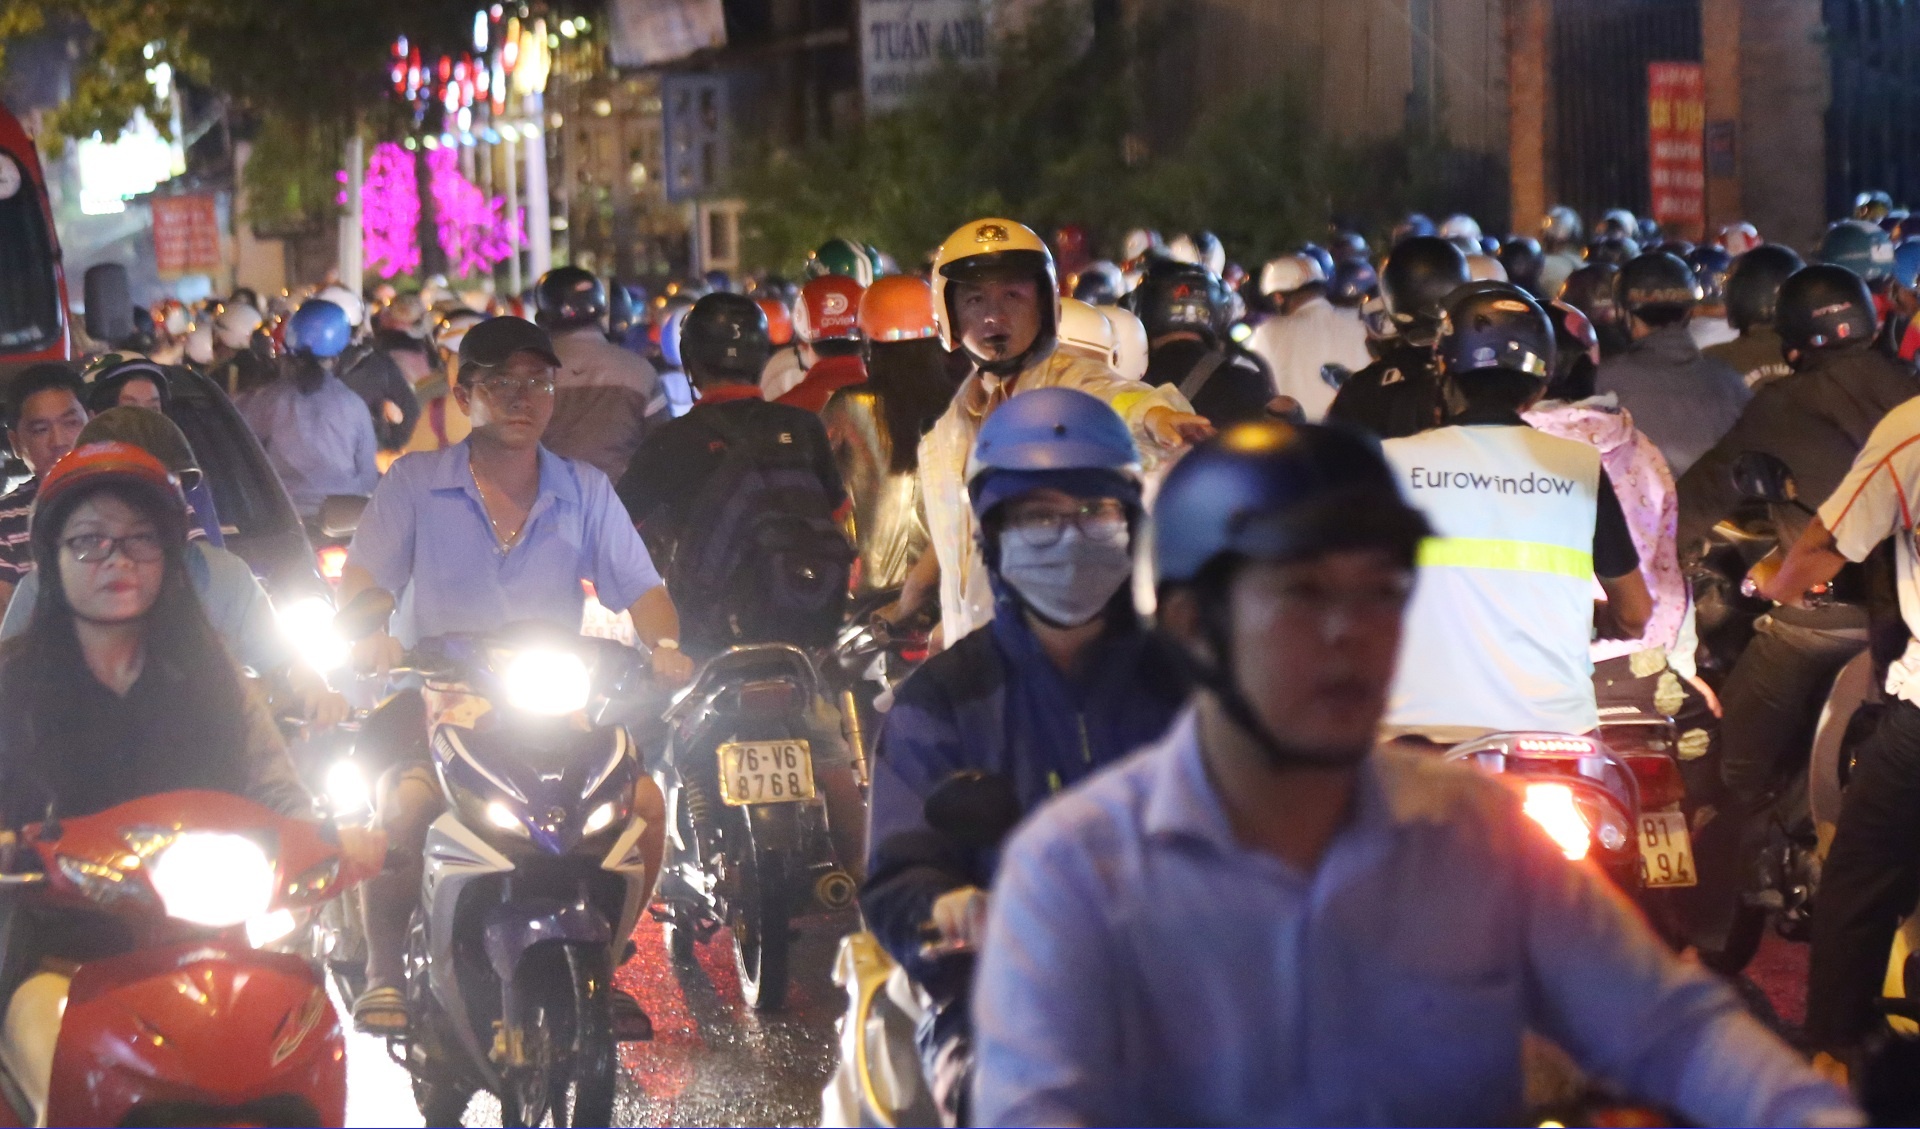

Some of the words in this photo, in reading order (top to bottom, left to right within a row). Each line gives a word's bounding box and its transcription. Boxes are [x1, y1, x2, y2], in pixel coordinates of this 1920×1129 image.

[1411, 467, 1575, 496] Eurowindow
[734, 745, 797, 773] 76-V6
[738, 772, 801, 800] 8768
